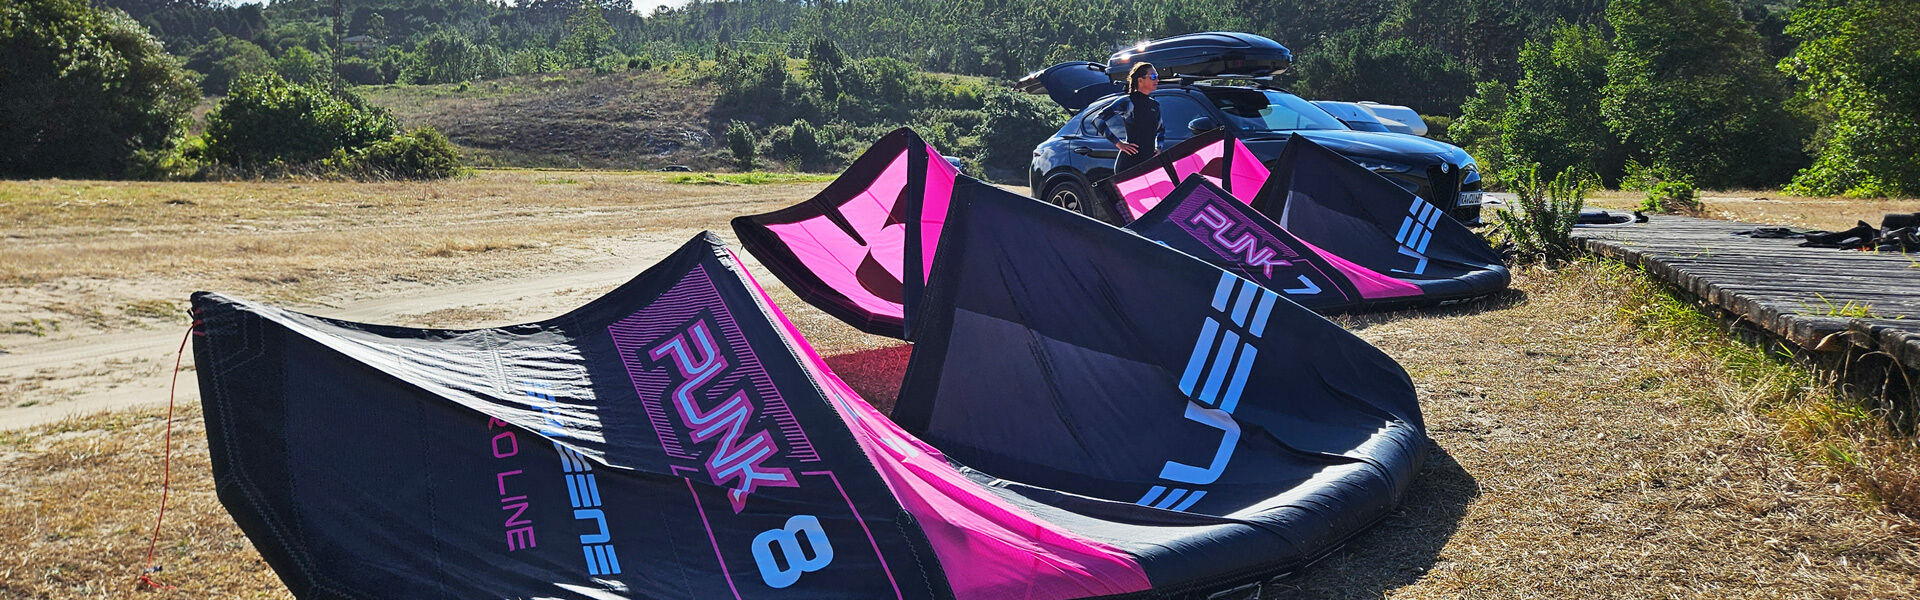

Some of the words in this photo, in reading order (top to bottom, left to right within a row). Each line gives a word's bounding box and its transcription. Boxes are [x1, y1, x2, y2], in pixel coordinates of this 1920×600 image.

[1190, 203, 1293, 280] PUNK
[1282, 274, 1322, 295] 7
[648, 318, 801, 515] PUNK
[751, 514, 834, 589] 8
[496, 469, 537, 552] LINE
